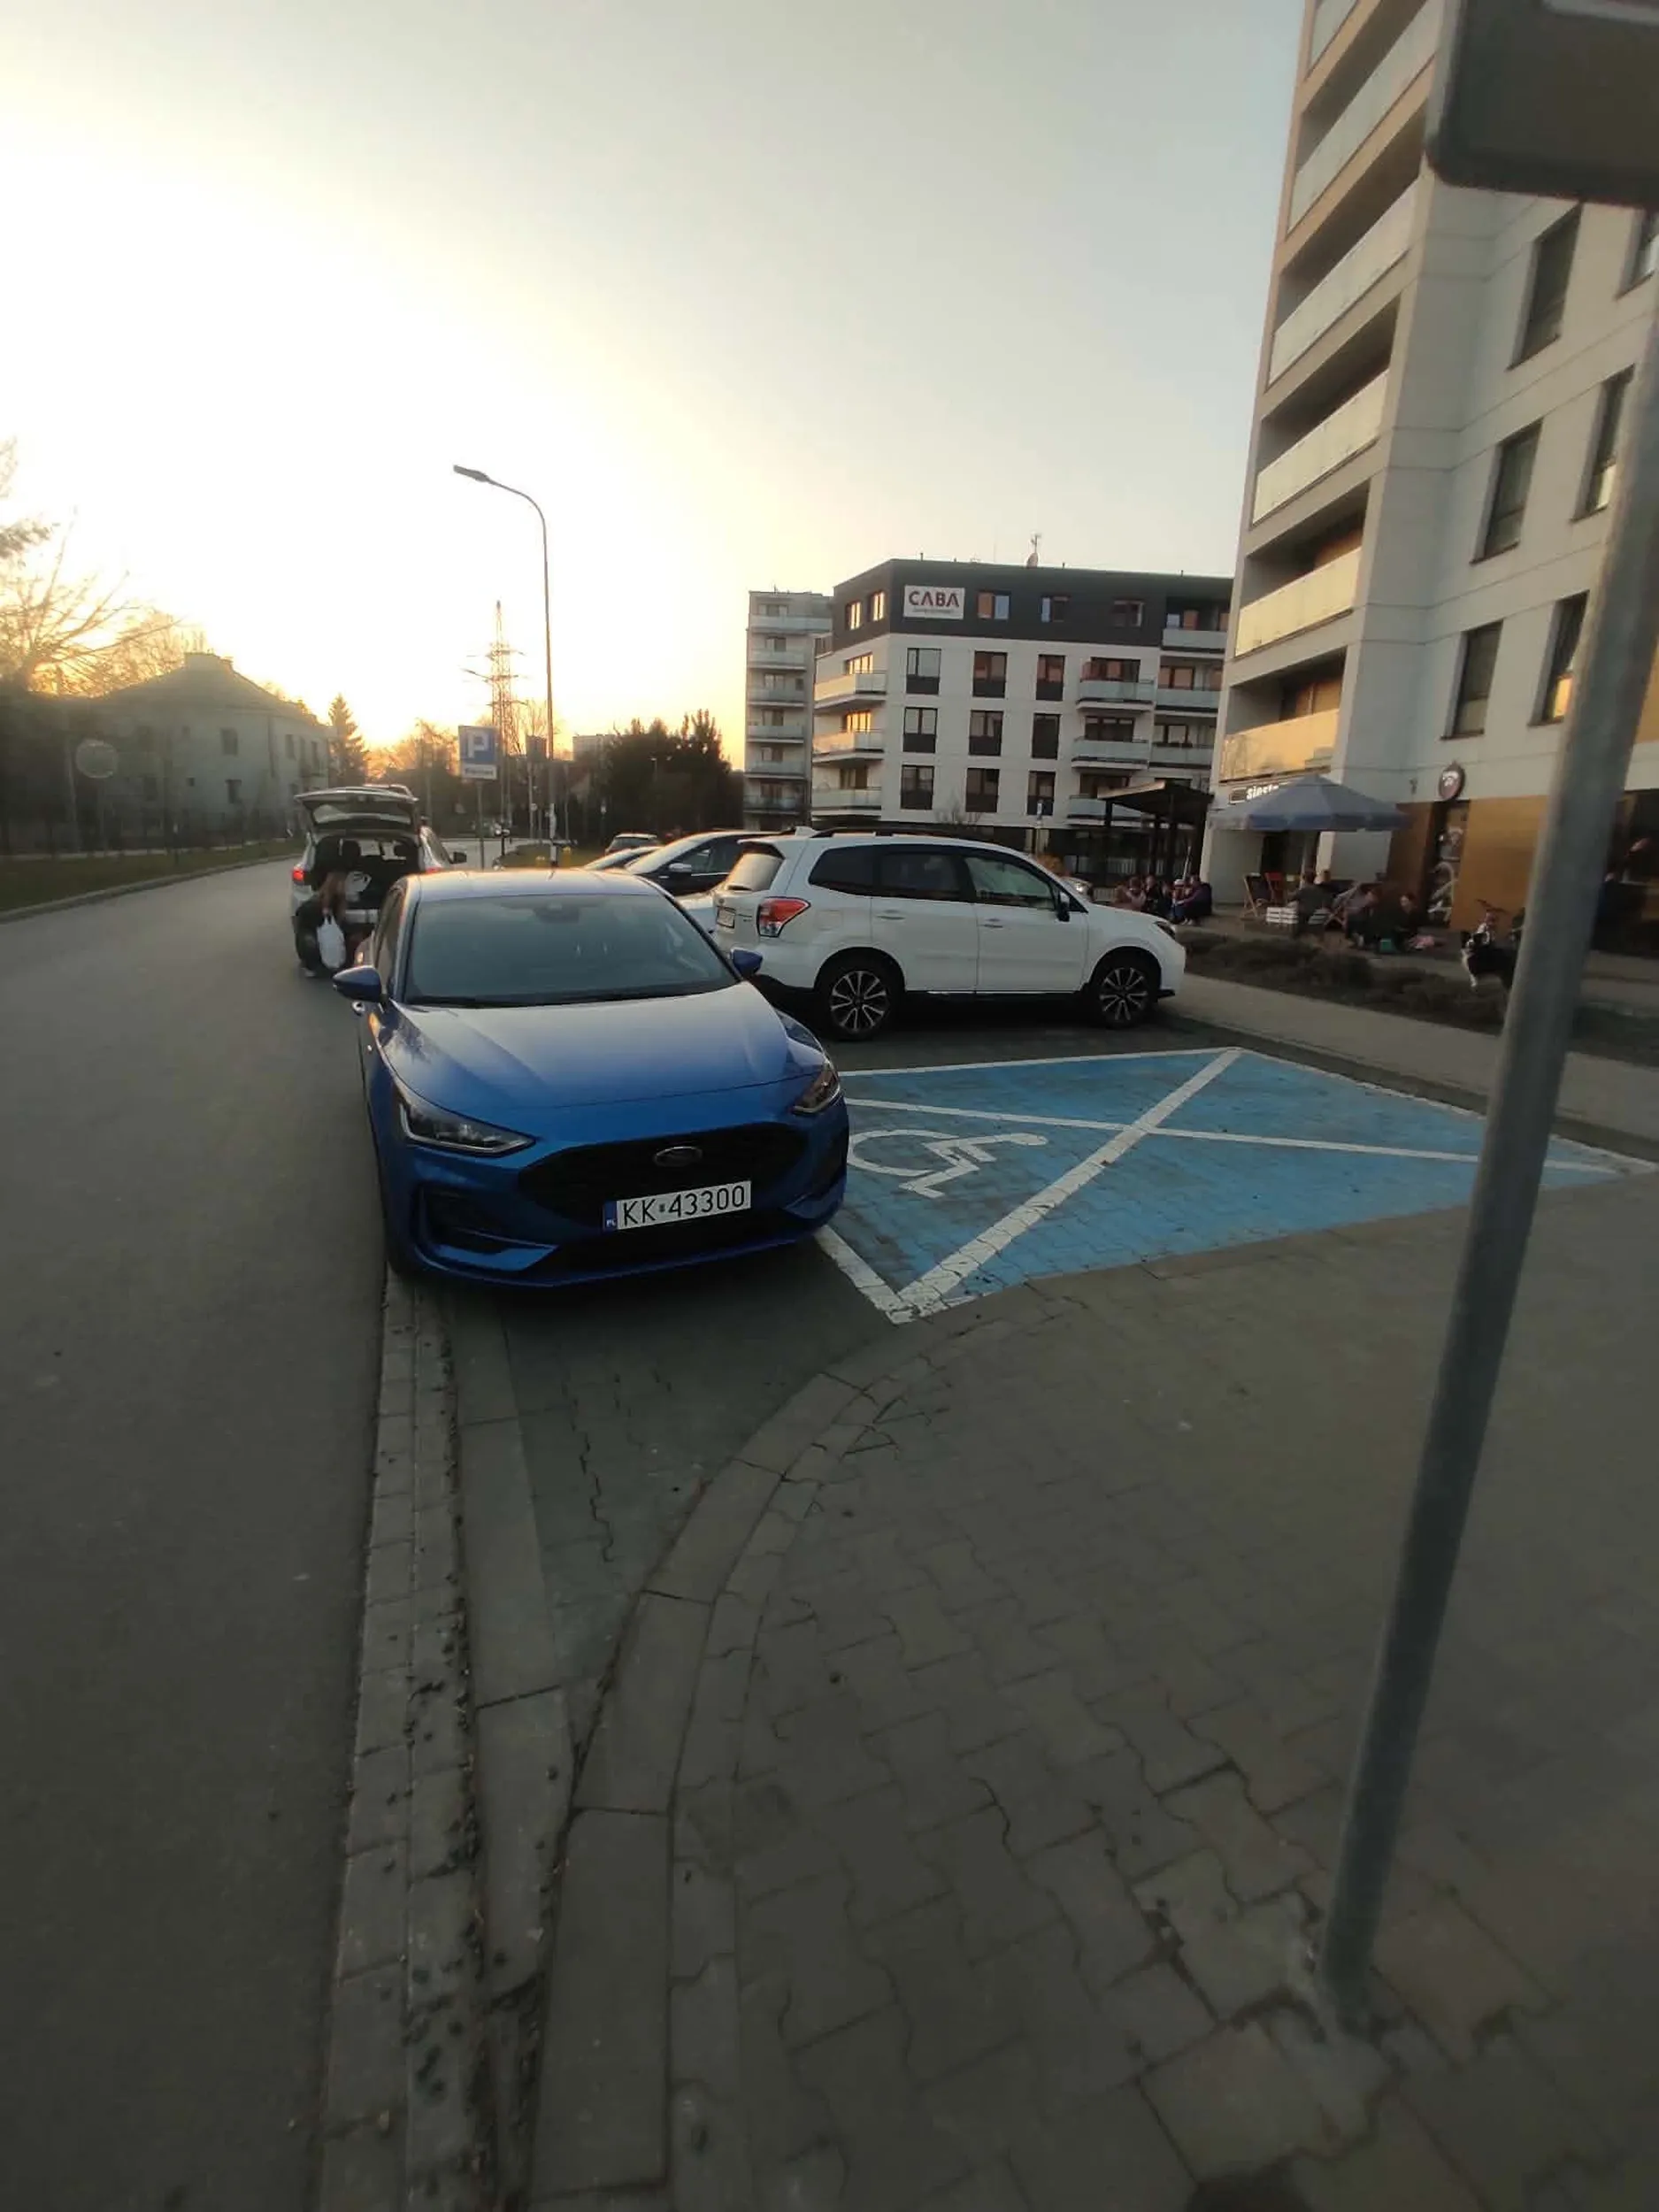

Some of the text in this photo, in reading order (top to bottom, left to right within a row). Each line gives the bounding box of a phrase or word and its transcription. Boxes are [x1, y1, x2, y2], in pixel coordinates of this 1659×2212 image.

[909, 590, 959, 607] CABA
[467, 730, 488, 758] P
[623, 1186, 745, 1226] KK 43300
